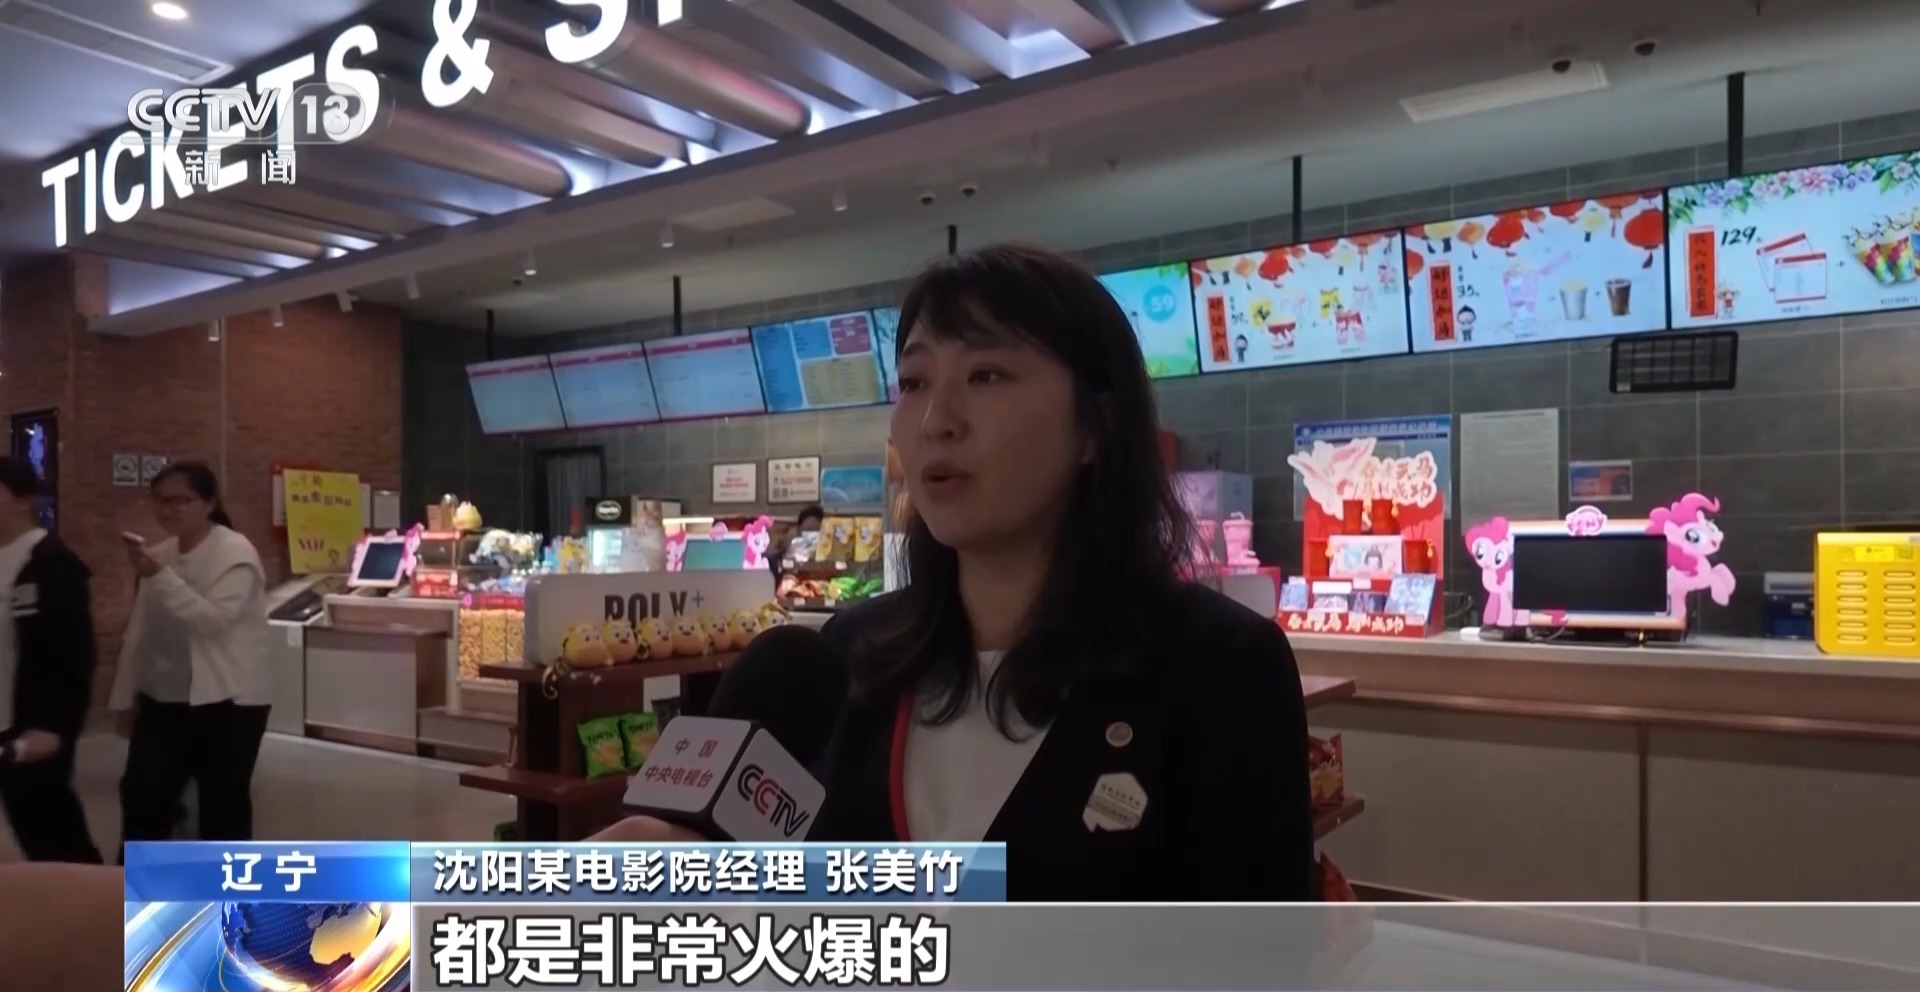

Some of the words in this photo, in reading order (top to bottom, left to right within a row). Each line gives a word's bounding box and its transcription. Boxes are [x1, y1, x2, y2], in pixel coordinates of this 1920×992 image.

[41, 24, 380, 247] TICKETS
[421, 0, 494, 108] &
[1151, 294, 1174, 312] 59
[675, 738, 718, 758] 中国
[646, 765, 713, 788] 中央电视台
[738, 763, 810, 838] CCTV
